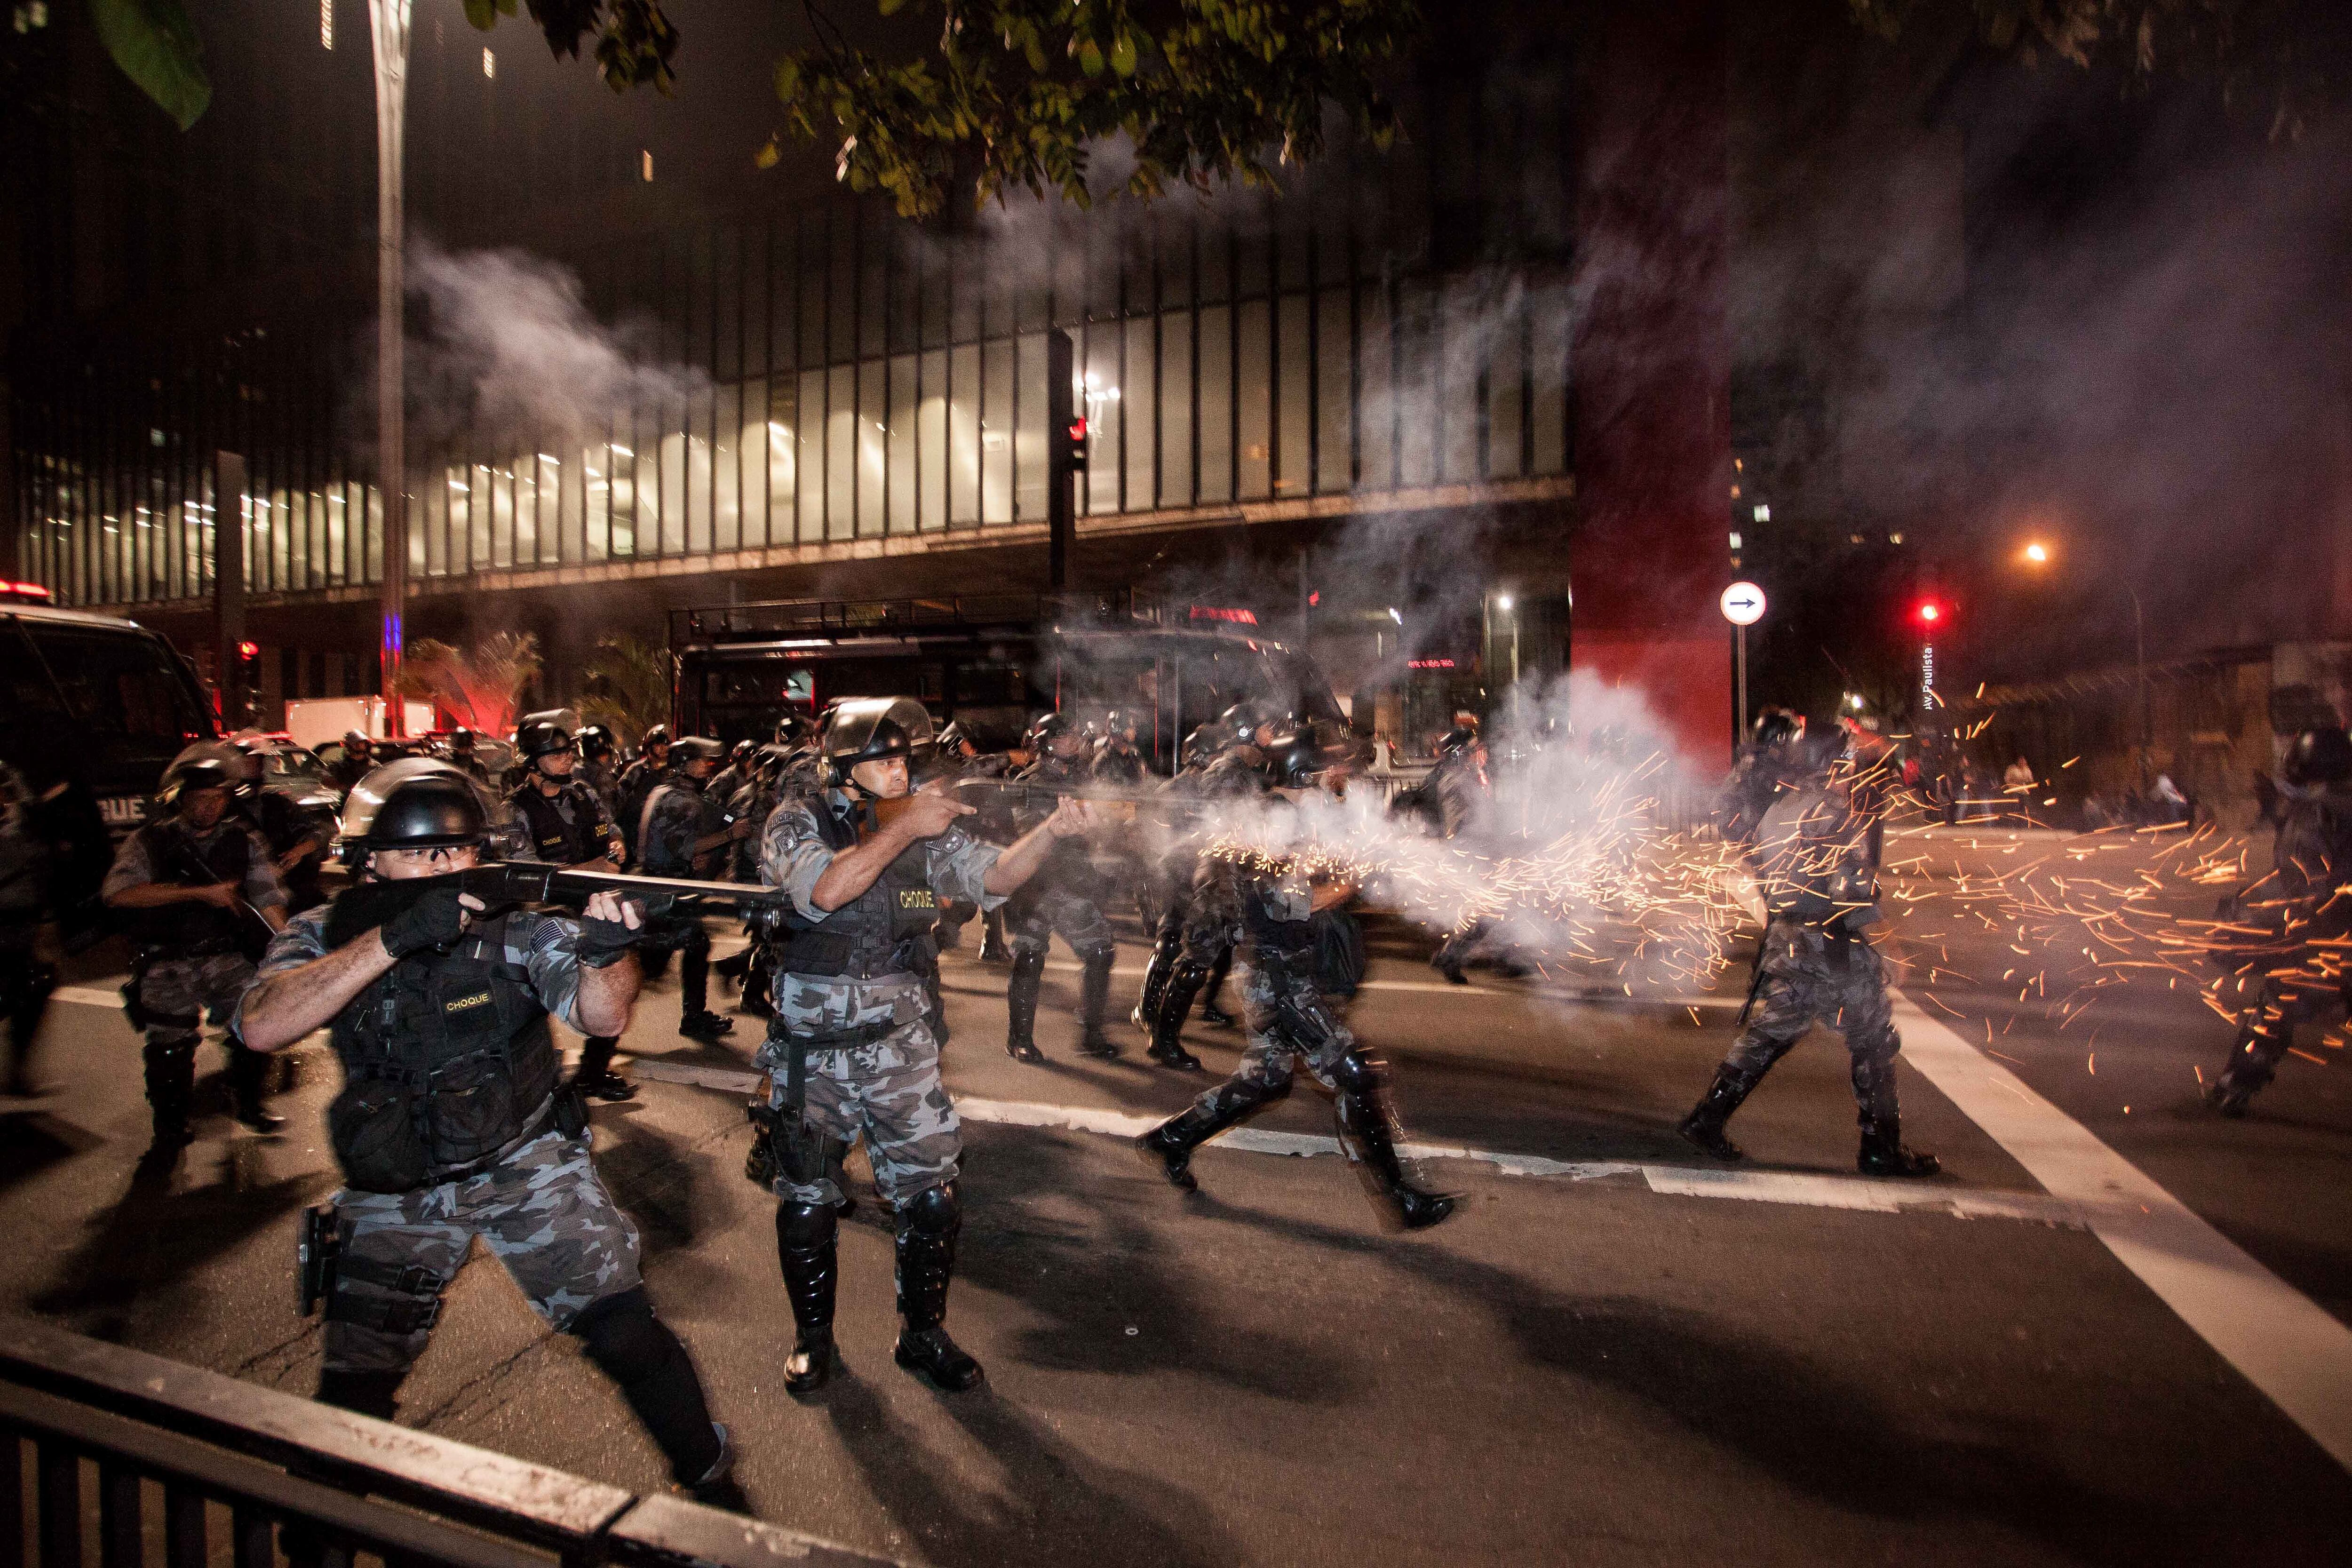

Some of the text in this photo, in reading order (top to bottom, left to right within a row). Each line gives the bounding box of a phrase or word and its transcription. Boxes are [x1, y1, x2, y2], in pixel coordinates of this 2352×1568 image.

[1923, 648, 1932, 710] Av. Paulista
[543, 836, 562, 845] CHOQUE
[900, 891, 934, 908] CHOQUE
[447, 994, 489, 1011] CHOQUE
